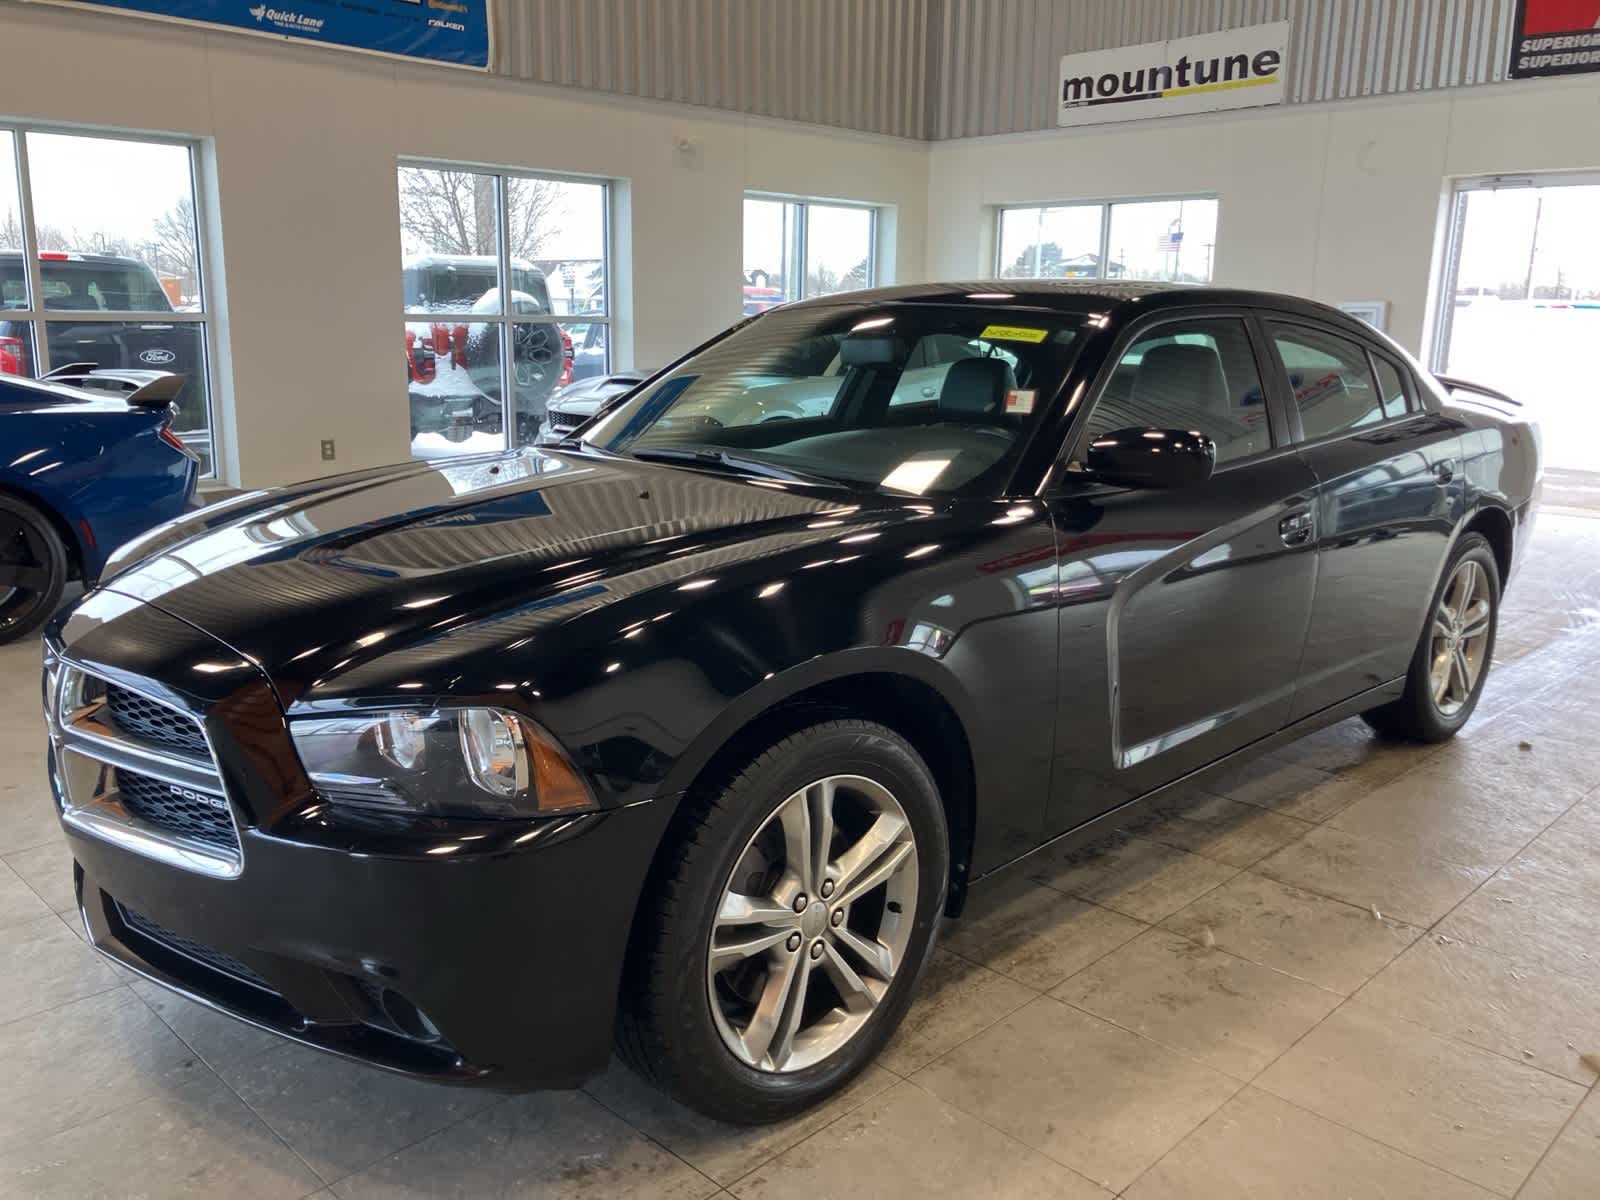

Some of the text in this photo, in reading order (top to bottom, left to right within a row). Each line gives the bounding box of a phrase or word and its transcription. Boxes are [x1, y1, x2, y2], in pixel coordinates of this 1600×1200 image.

[266, 9, 297, 23] Quick
[297, 14, 325, 28] Lane
[428, 19, 465, 31] FALKEN
[1062, 50, 1281, 101] mountune
[143, 350, 171, 361] Ford
